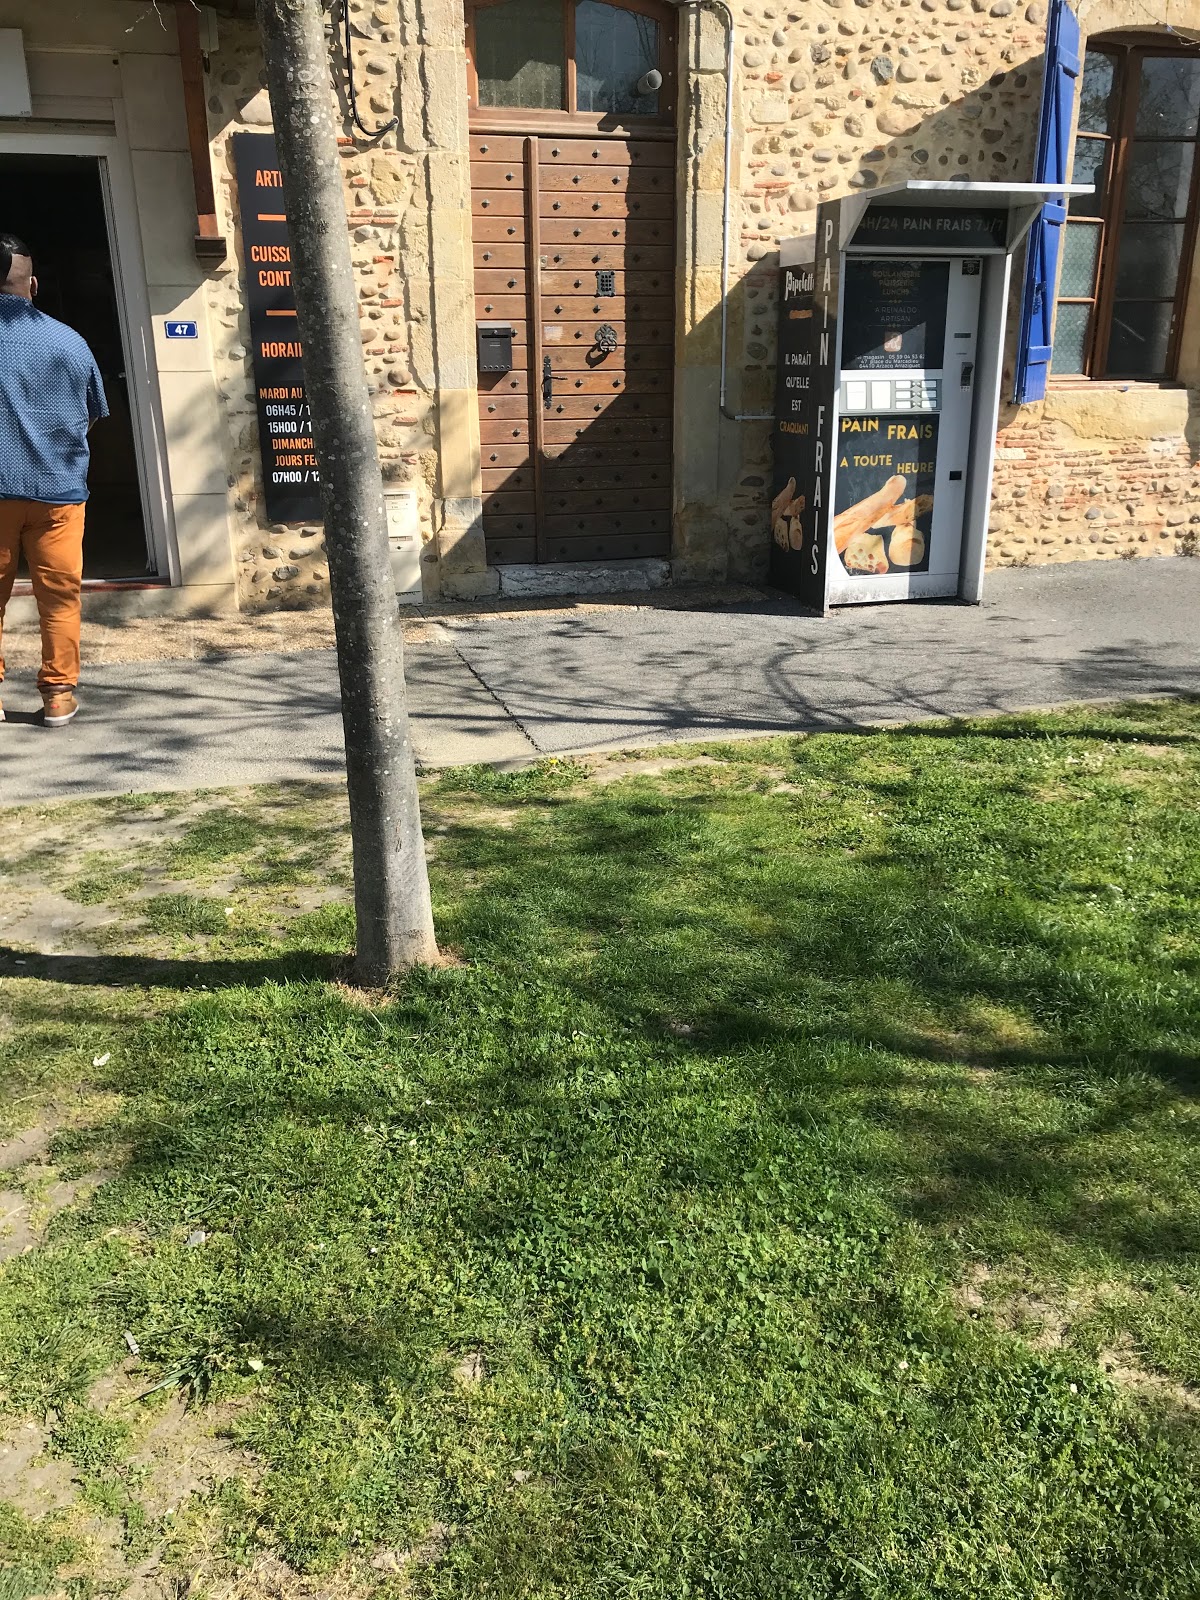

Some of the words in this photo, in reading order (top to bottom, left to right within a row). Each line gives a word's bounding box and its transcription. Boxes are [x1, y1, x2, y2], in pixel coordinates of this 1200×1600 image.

[902, 217, 931, 230] PAIN
[936, 218, 972, 231] FRAIS
[784, 270, 815, 301] Pipelett
[819, 219, 834, 366] PAIN
[174, 324, 188, 335] 47
[259, 387, 289, 399] MARDI
[291, 387, 303, 399] AU
[265, 404, 296, 416] 06H45
[791, 399, 802, 412] EST
[267, 421, 297, 433] 15H00
[841, 416, 879, 433] PAIN
[887, 424, 933, 440] FRAIS
[272, 437, 316, 450] DIMANCH
[274, 454, 303, 467] JOURS
[839, 456, 849, 468] A
[853, 454, 893, 467] TOUTE
[896, 461, 934, 474] HEURE
[272, 470, 302, 483] 07H00
[811, 405, 825, 576] FRAIS
